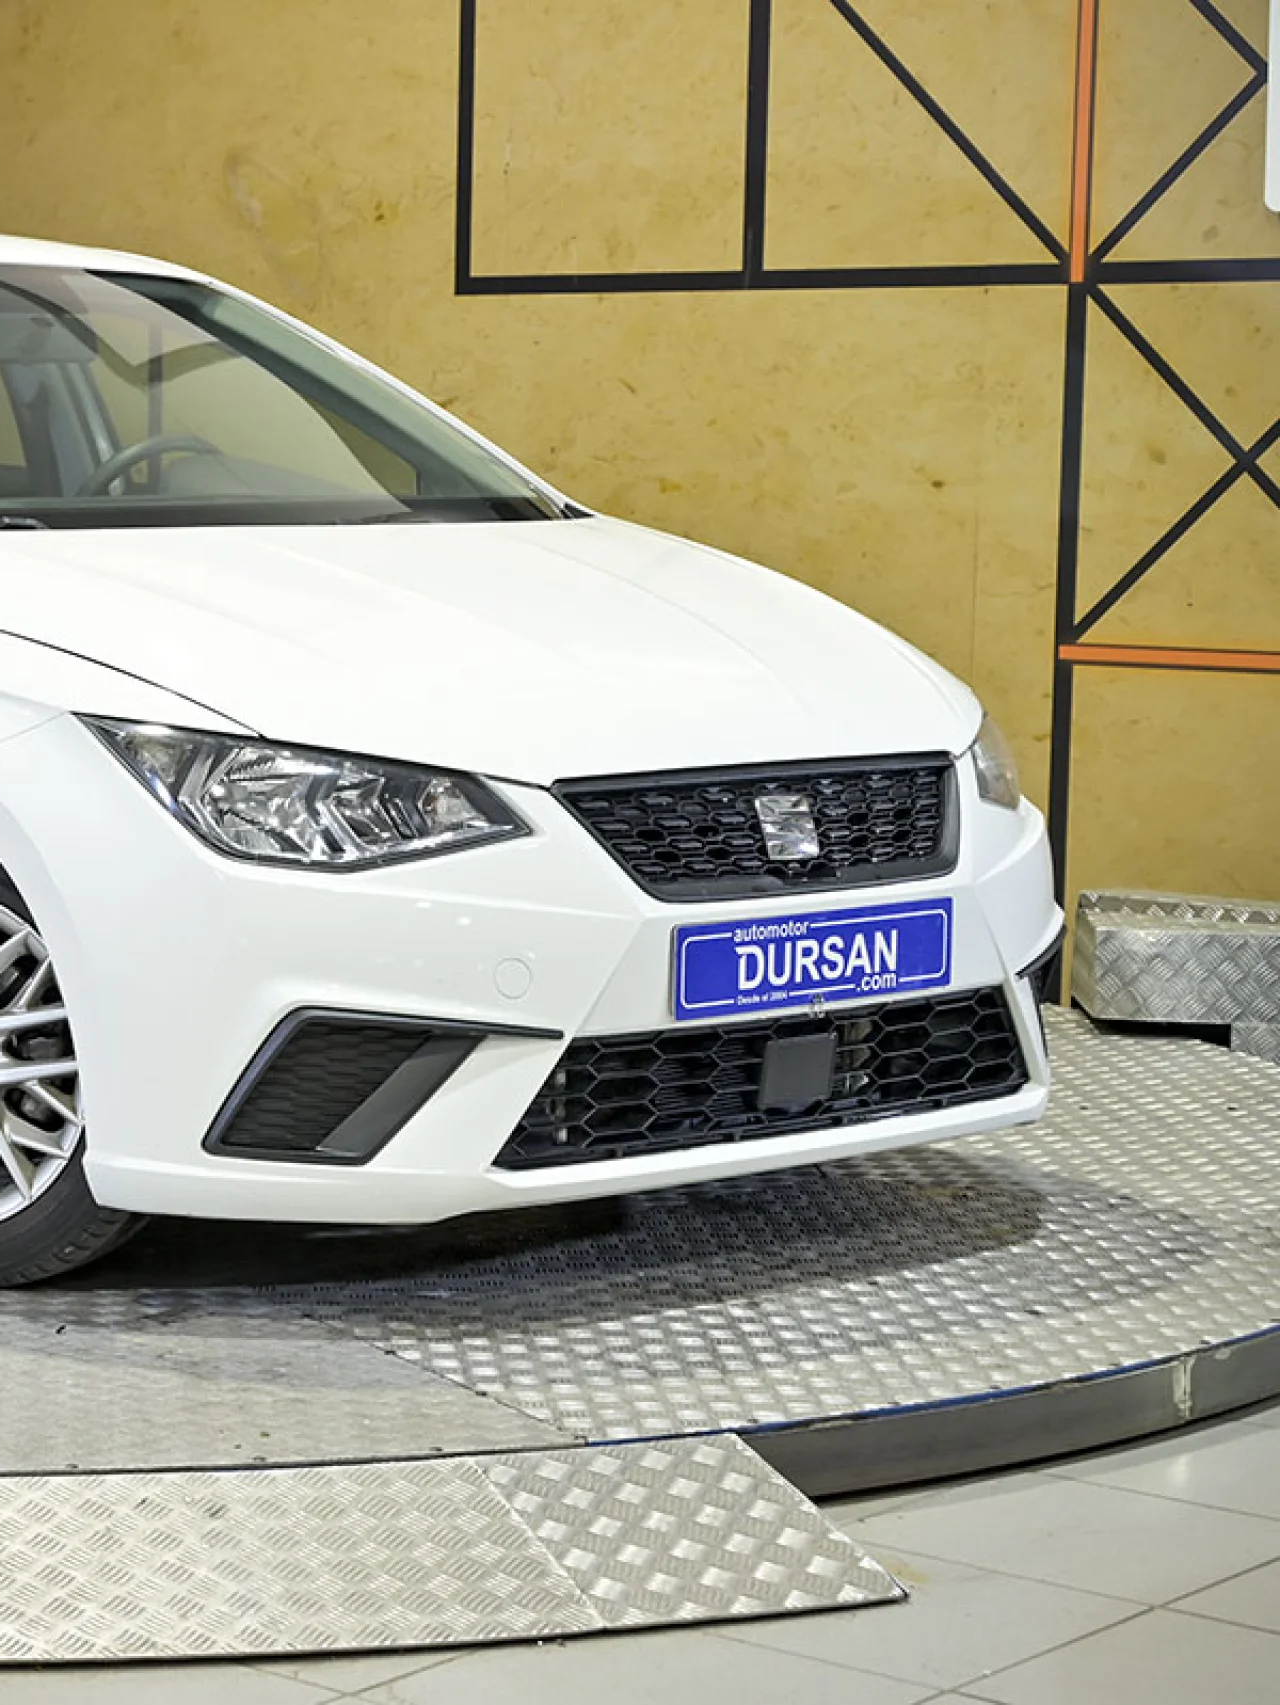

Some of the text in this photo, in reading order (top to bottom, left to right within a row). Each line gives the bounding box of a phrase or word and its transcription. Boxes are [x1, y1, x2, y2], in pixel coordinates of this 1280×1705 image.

[733, 919, 810, 943] automotor
[734, 928, 899, 991] DURSAN
[855, 972, 897, 993] .com
